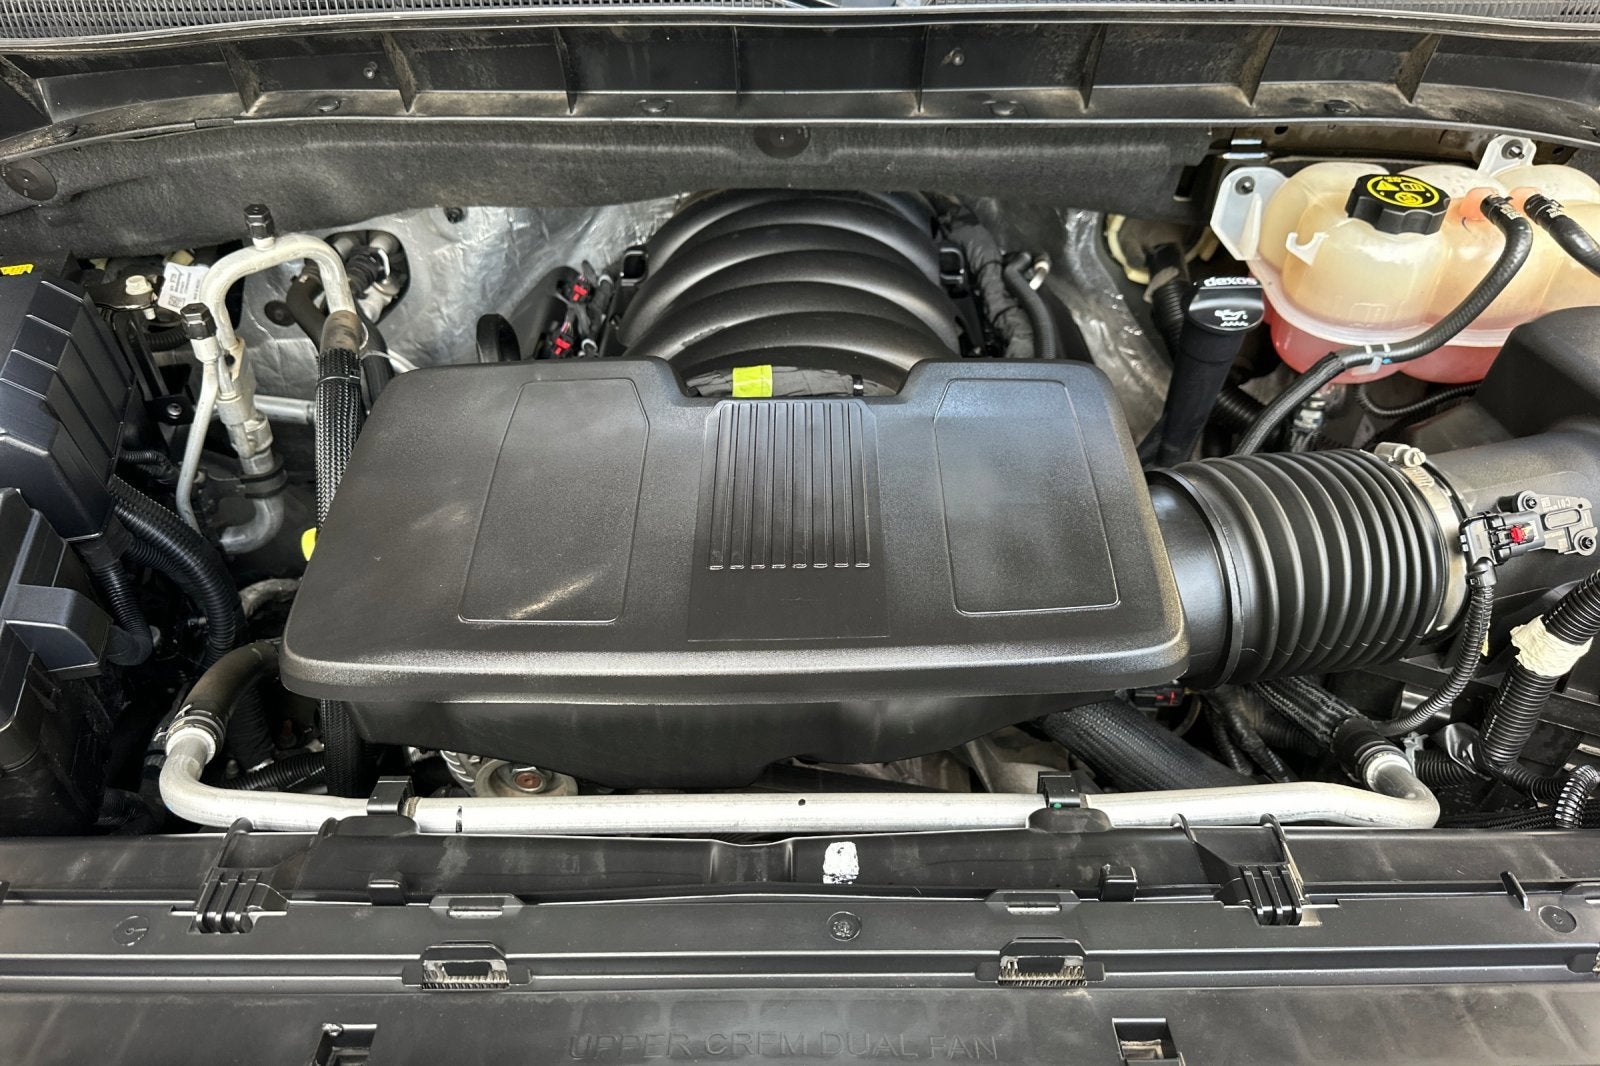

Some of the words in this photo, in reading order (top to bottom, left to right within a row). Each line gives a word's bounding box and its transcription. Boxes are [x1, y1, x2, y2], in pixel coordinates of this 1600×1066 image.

[569, 1032, 693, 1060] UPPER
[819, 1032, 919, 1059] DUAL
[929, 1034, 998, 1061] FAN
